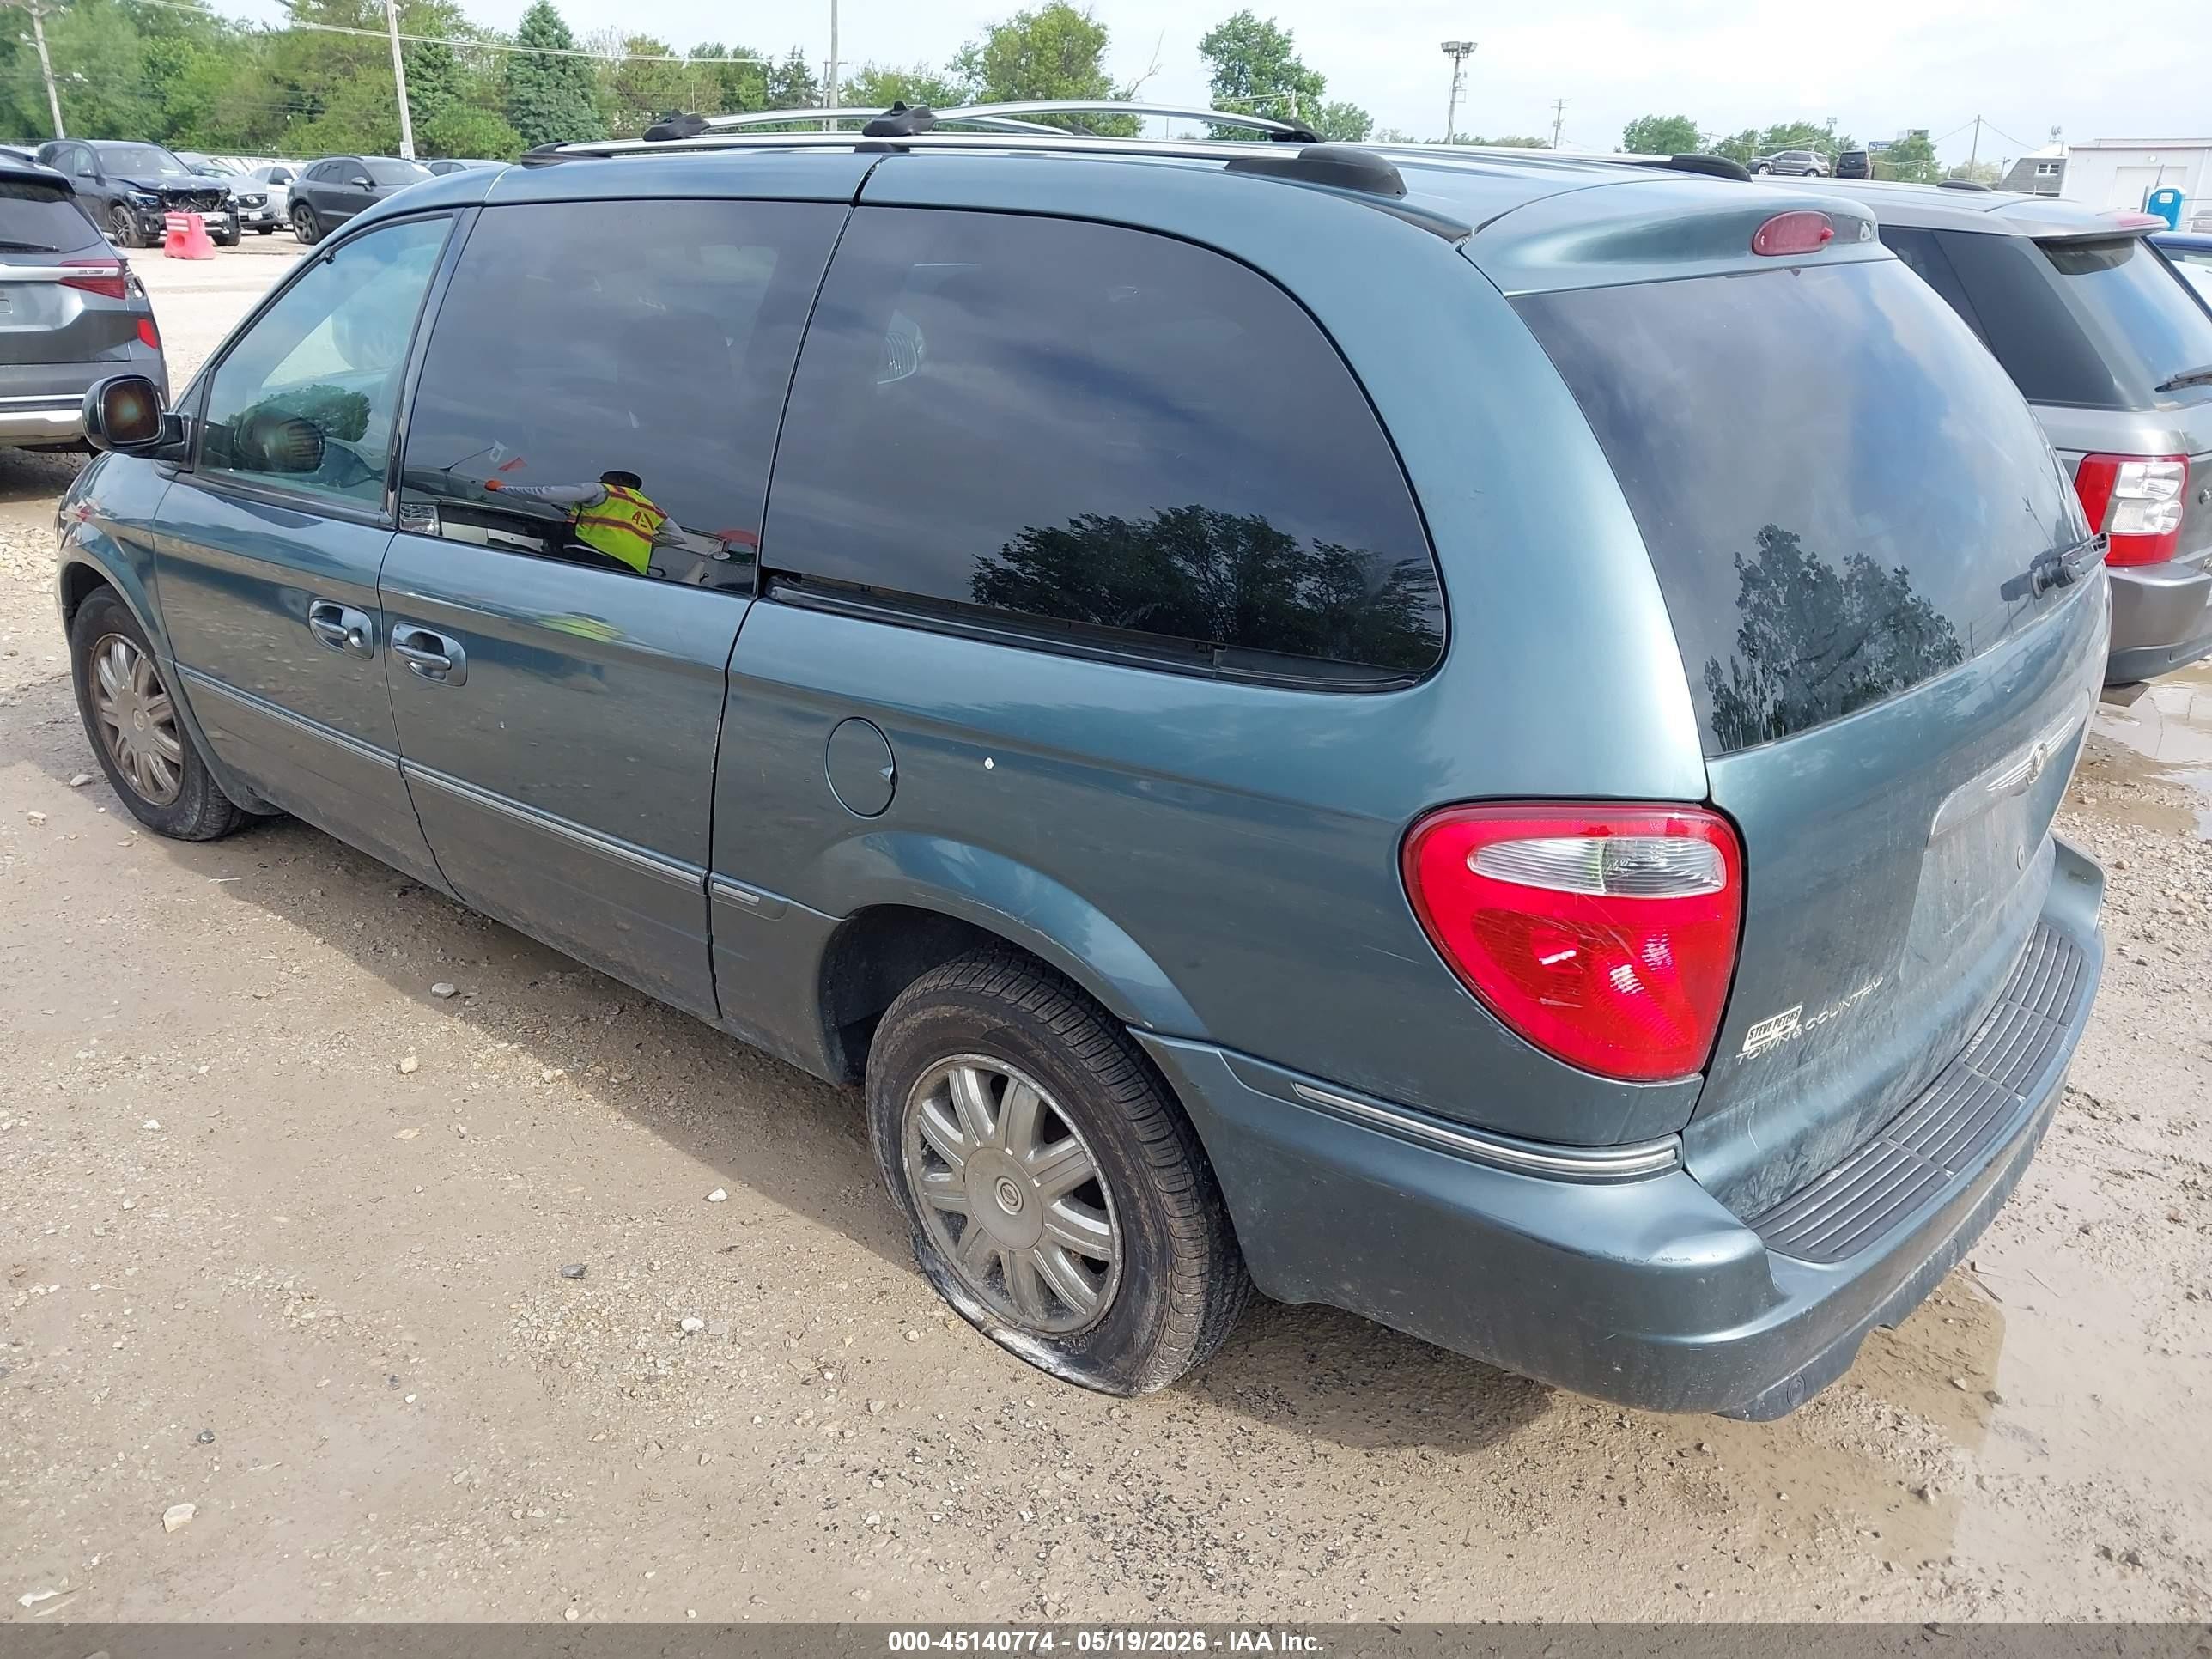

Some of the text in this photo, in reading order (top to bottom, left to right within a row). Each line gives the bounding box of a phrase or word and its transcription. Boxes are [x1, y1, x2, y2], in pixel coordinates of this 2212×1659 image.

[1735, 1031, 1791, 1066] TOWN
[1804, 975, 1884, 1031] COUNTRY
[1748, 1020, 1773, 1041] STEVE
[1773, 1009, 1801, 1030] PETERS
